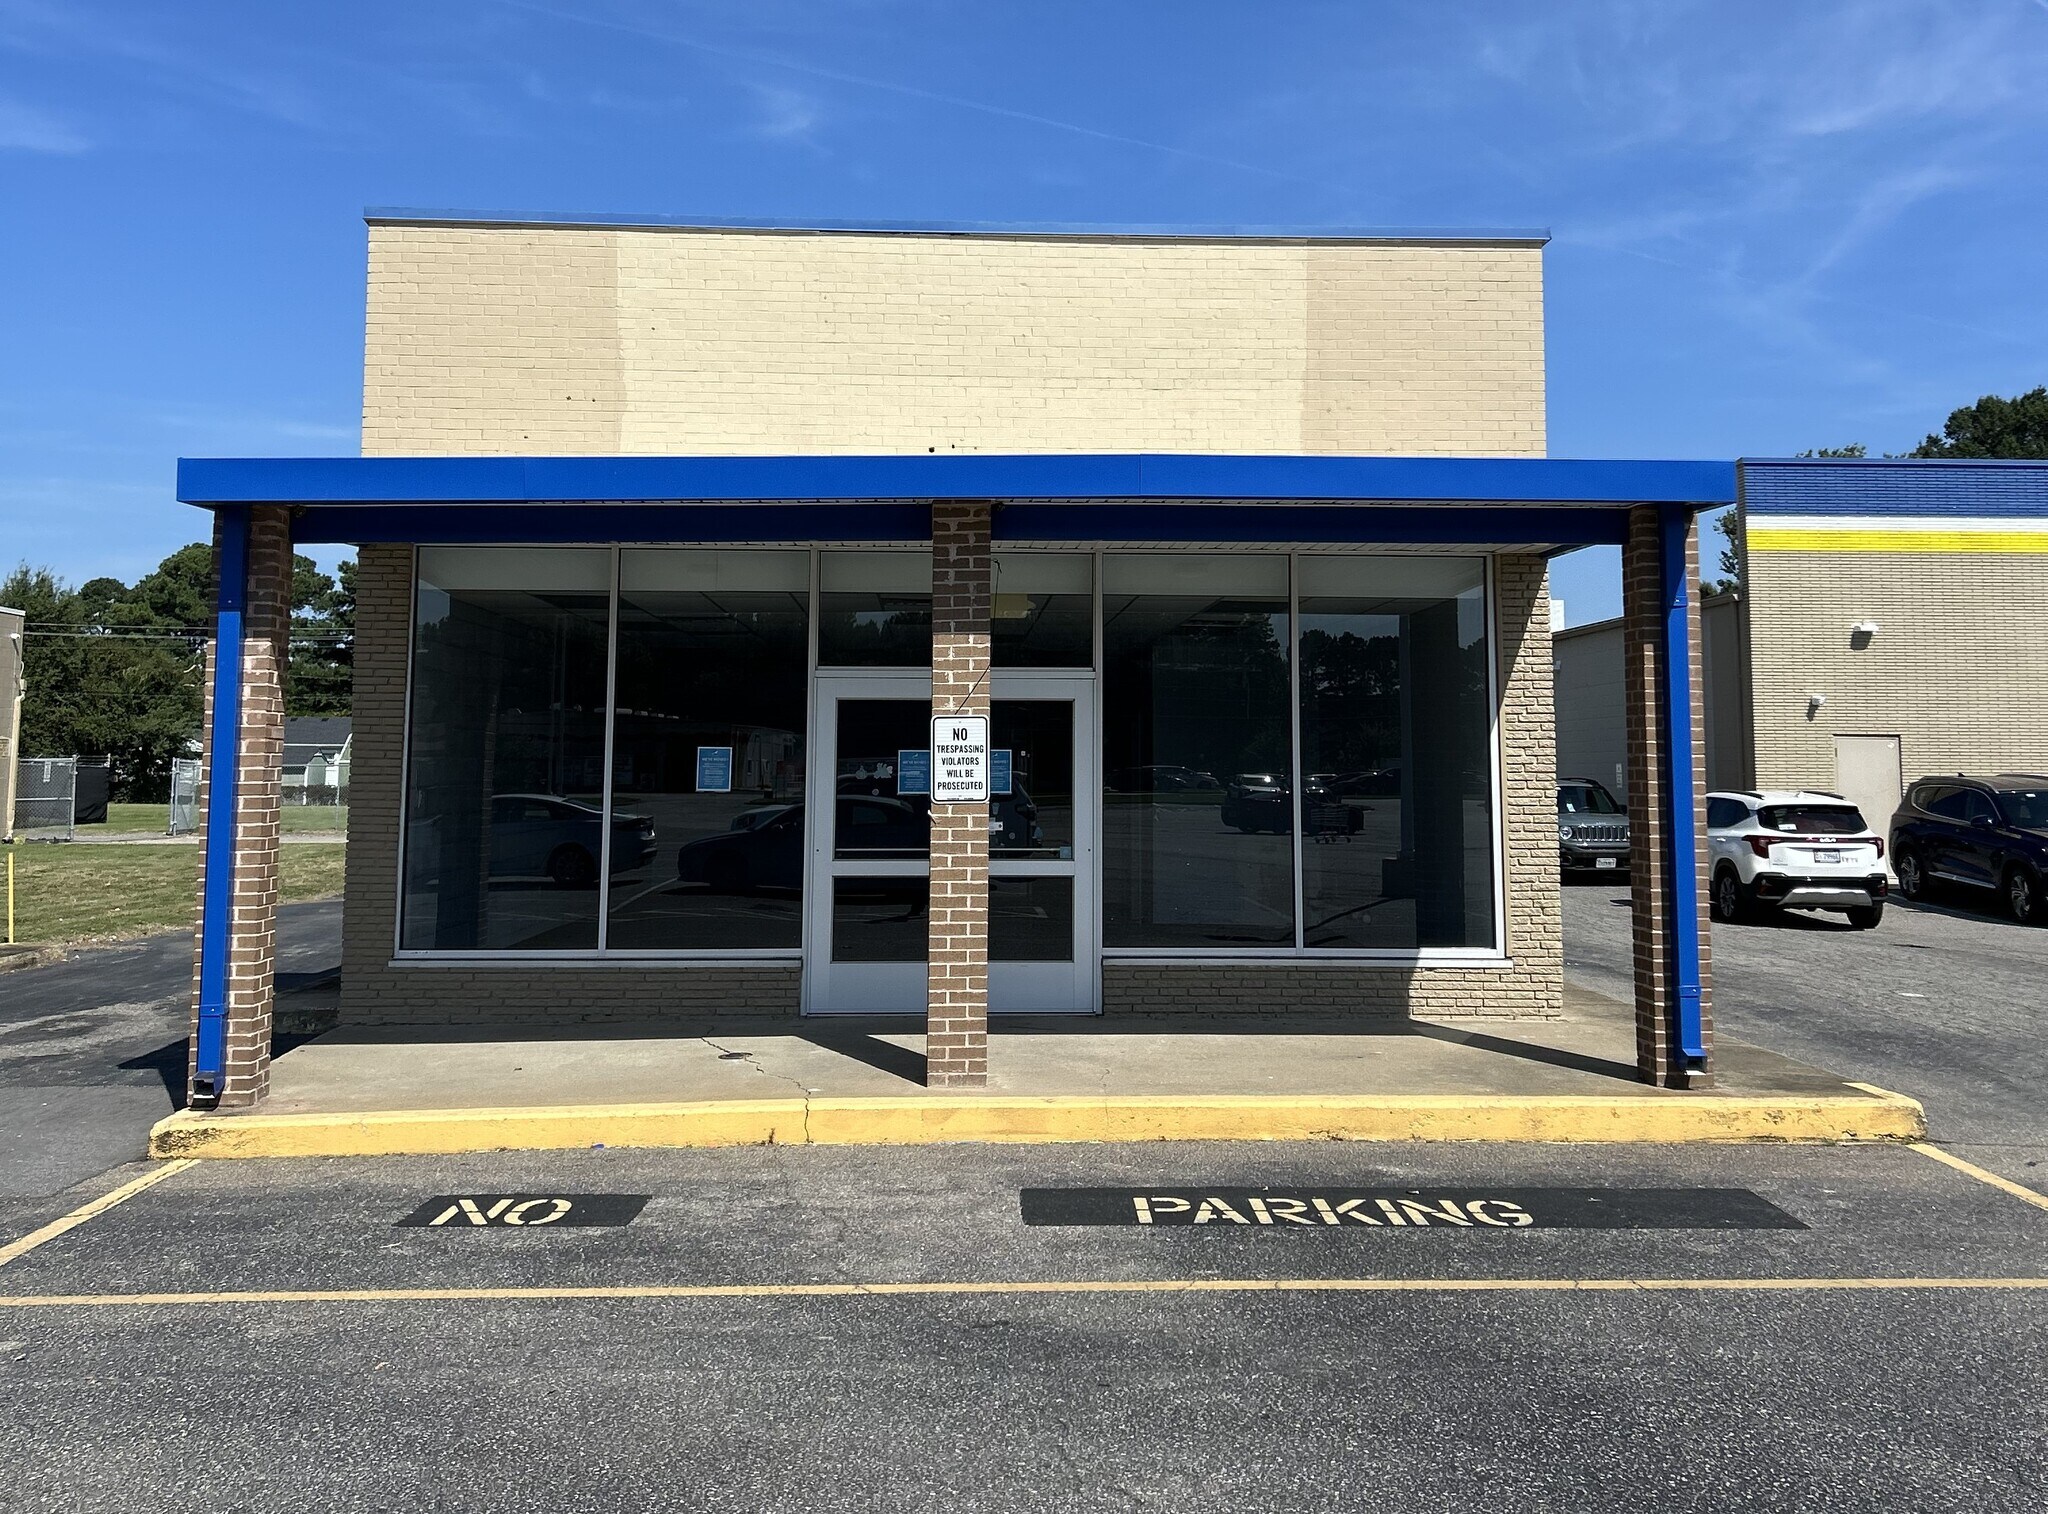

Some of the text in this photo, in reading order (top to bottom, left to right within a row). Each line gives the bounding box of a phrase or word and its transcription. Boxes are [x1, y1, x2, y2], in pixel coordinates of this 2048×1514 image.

[952, 727, 968, 741] NO
[936, 744, 984, 754] TRESPASSING
[941, 756, 980, 766] VIOLATORS
[946, 769, 975, 778] WILL BE
[937, 781, 984, 791] PROSECUTED
[428, 1198, 573, 1226] NO
[1132, 1197, 1534, 1226] PARKING
